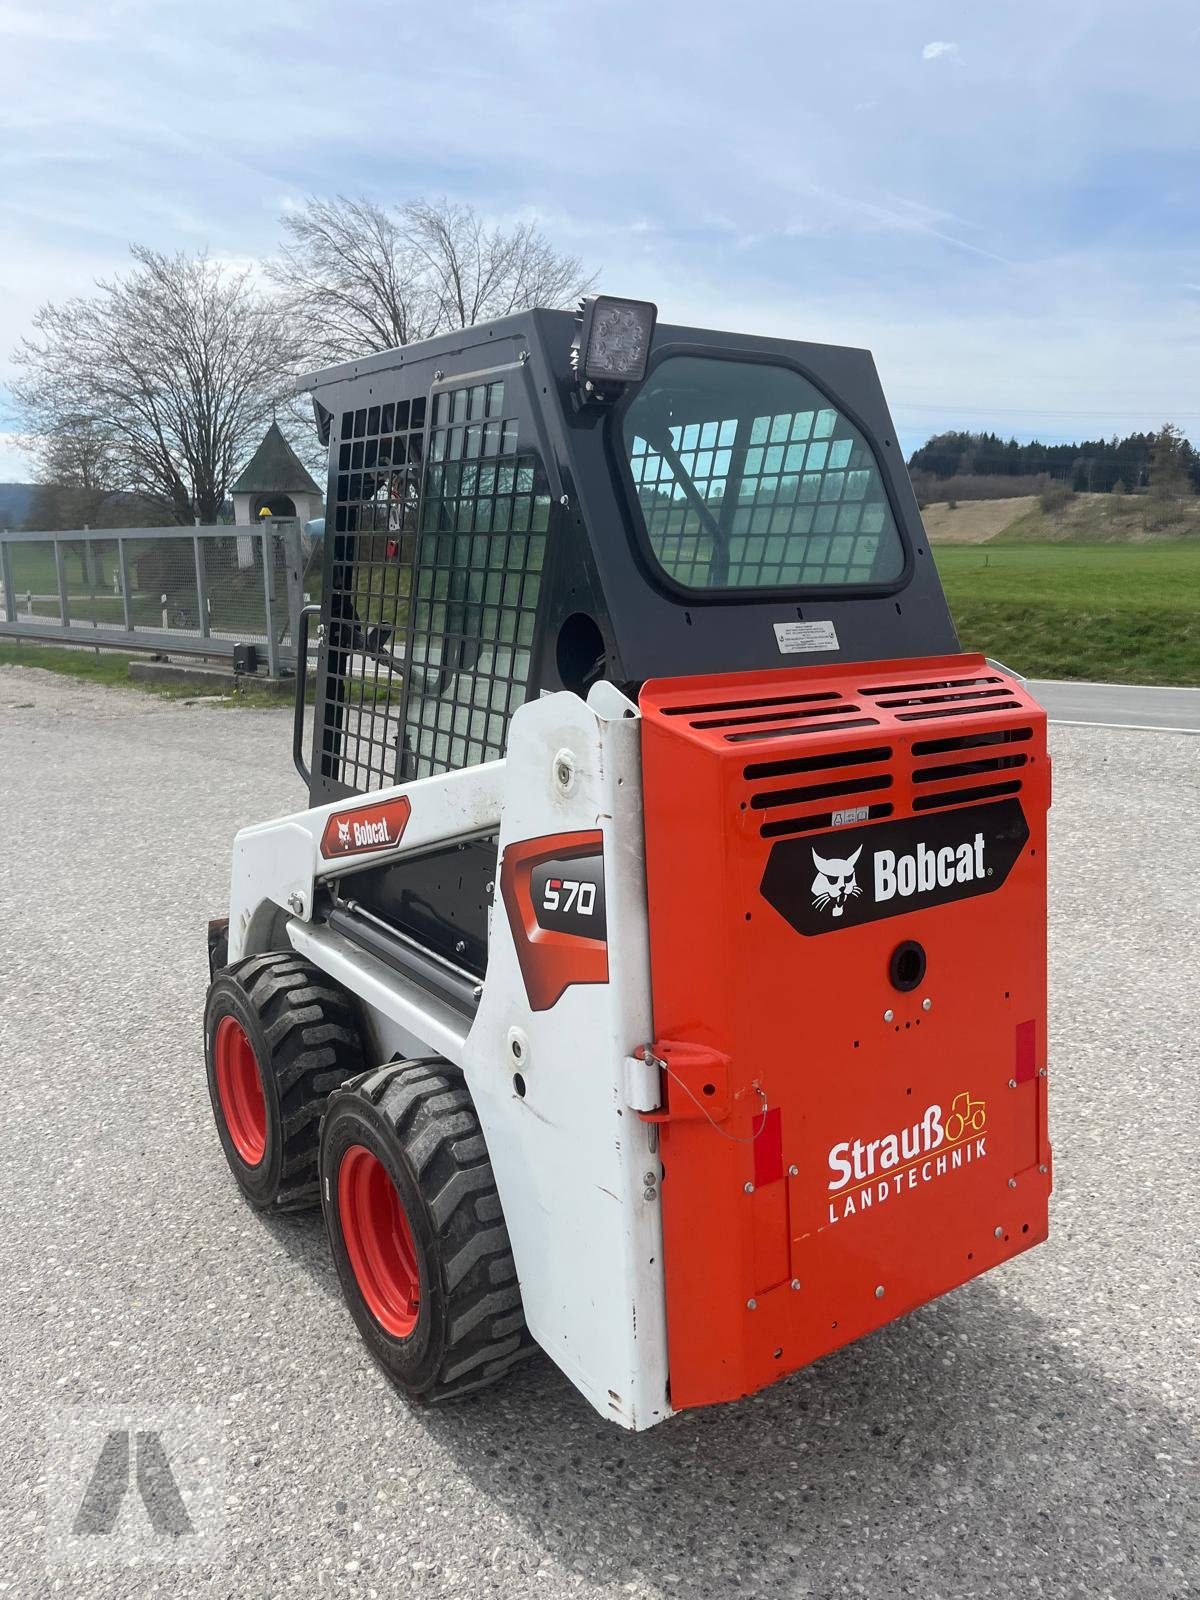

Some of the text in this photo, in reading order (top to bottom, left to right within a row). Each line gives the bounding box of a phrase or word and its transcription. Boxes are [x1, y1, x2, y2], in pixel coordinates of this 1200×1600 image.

[353, 817, 389, 847] Bobcat
[873, 832, 985, 902] Bobcat
[543, 879, 596, 915] S70
[828, 1104, 944, 1190] Strauß
[829, 1138, 986, 1223] LANDTECHNIK
